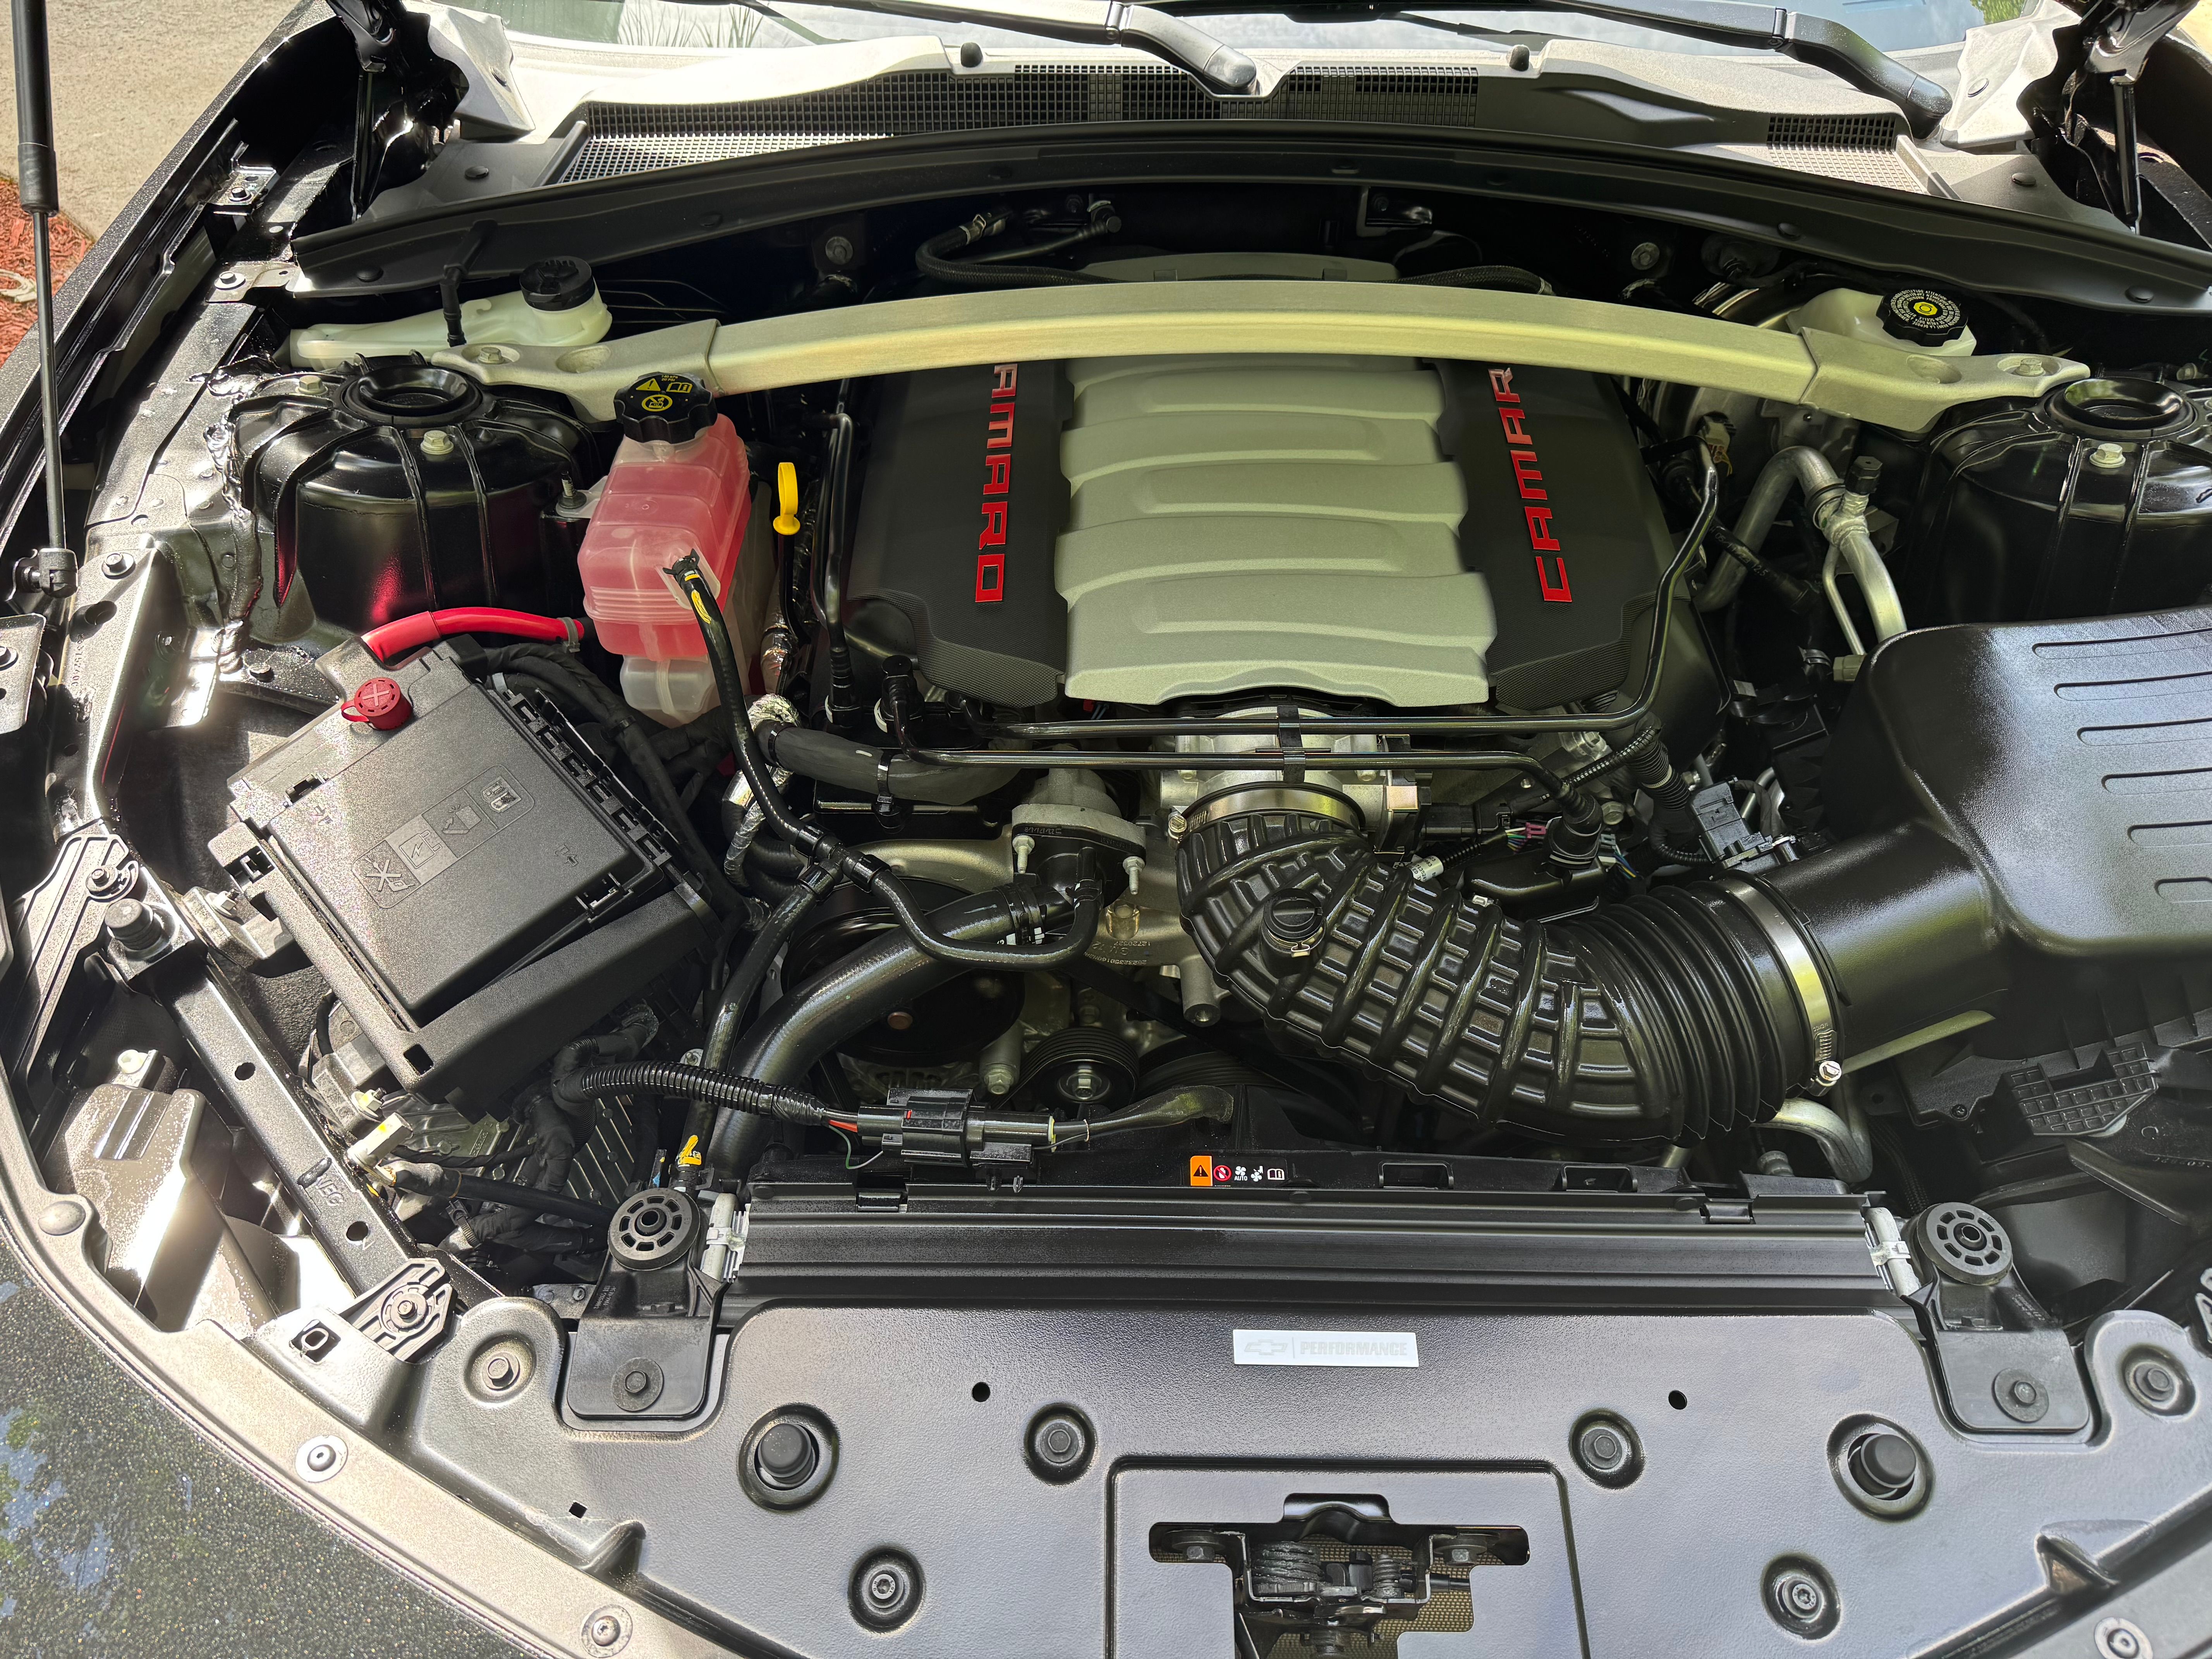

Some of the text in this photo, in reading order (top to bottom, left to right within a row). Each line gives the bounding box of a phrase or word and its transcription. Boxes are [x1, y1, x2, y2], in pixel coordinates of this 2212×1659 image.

[975, 363, 1018, 603] AMARO
[1488, 367, 1572, 602] CAMAR
[1300, 1341, 1408, 1356] PERFORMANCE
